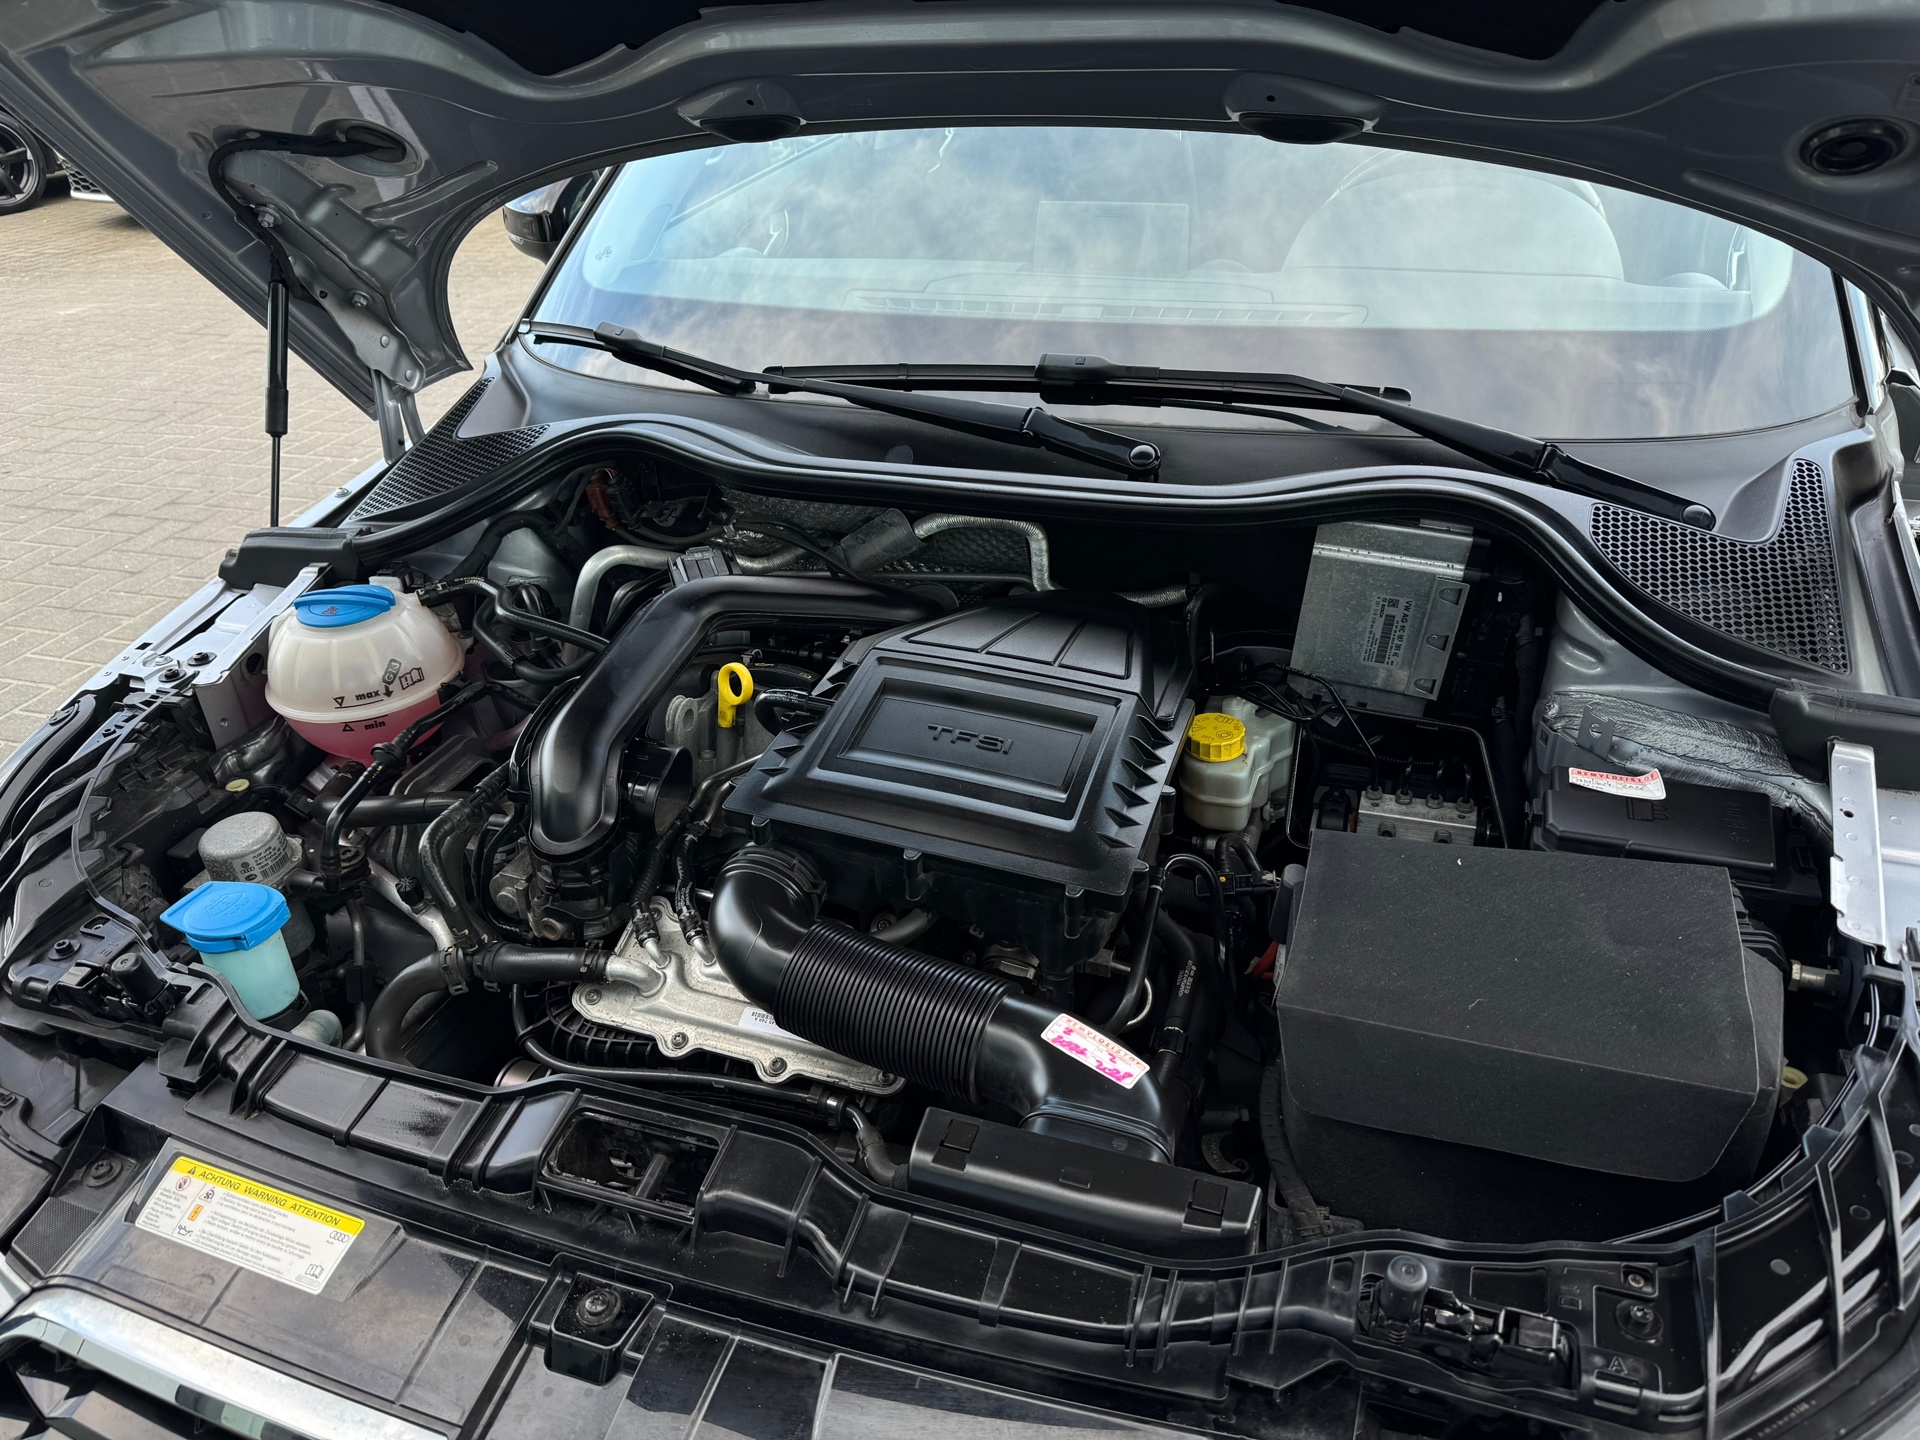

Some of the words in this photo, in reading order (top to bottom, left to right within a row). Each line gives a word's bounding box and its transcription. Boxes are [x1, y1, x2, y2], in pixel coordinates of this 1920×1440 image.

[1403, 600, 1412, 612] VW
[1400, 613, 1409, 624] AG
[385, 661, 400, 682] G13
[355, 690, 381, 701] max
[364, 720, 386, 730] min
[927, 723, 1013, 755] TFSI
[198, 1170, 241, 1190] ACHTUNG
[244, 1186, 287, 1206] WARNING
[290, 1202, 341, 1226] ATTENTION
